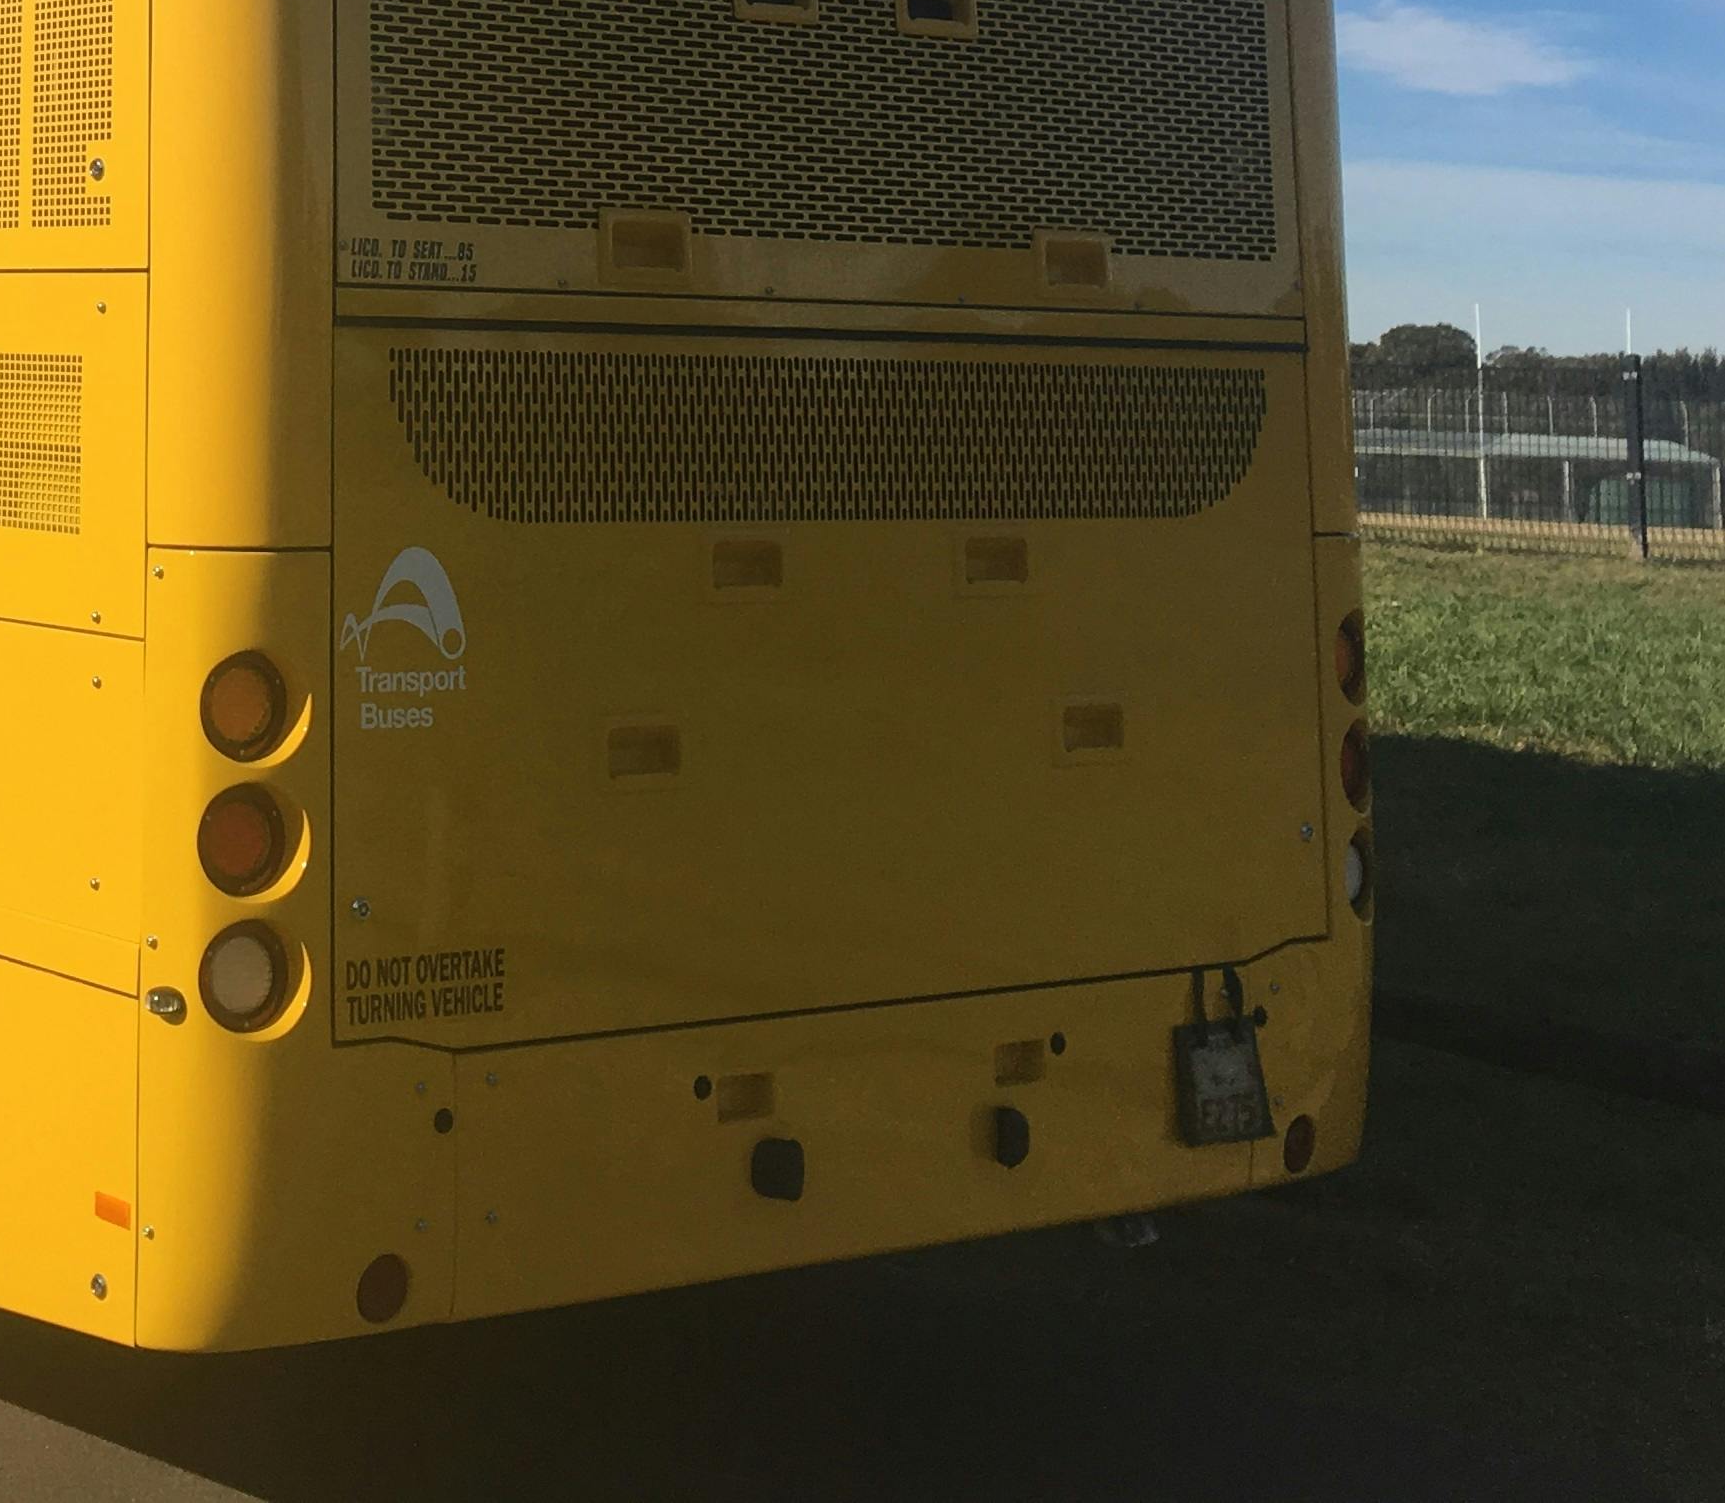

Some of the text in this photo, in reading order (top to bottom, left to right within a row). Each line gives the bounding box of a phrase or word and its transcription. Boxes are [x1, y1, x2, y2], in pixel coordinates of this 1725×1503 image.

[391, 239, 407, 259] TO
[387, 260, 402, 280] TO
[355, 664, 467, 697] Transport
[360, 701, 434, 729] Buses
[346, 947, 506, 990] DO NOT OVERTAKE
[346, 981, 504, 1026] TURNING VEHICLE
